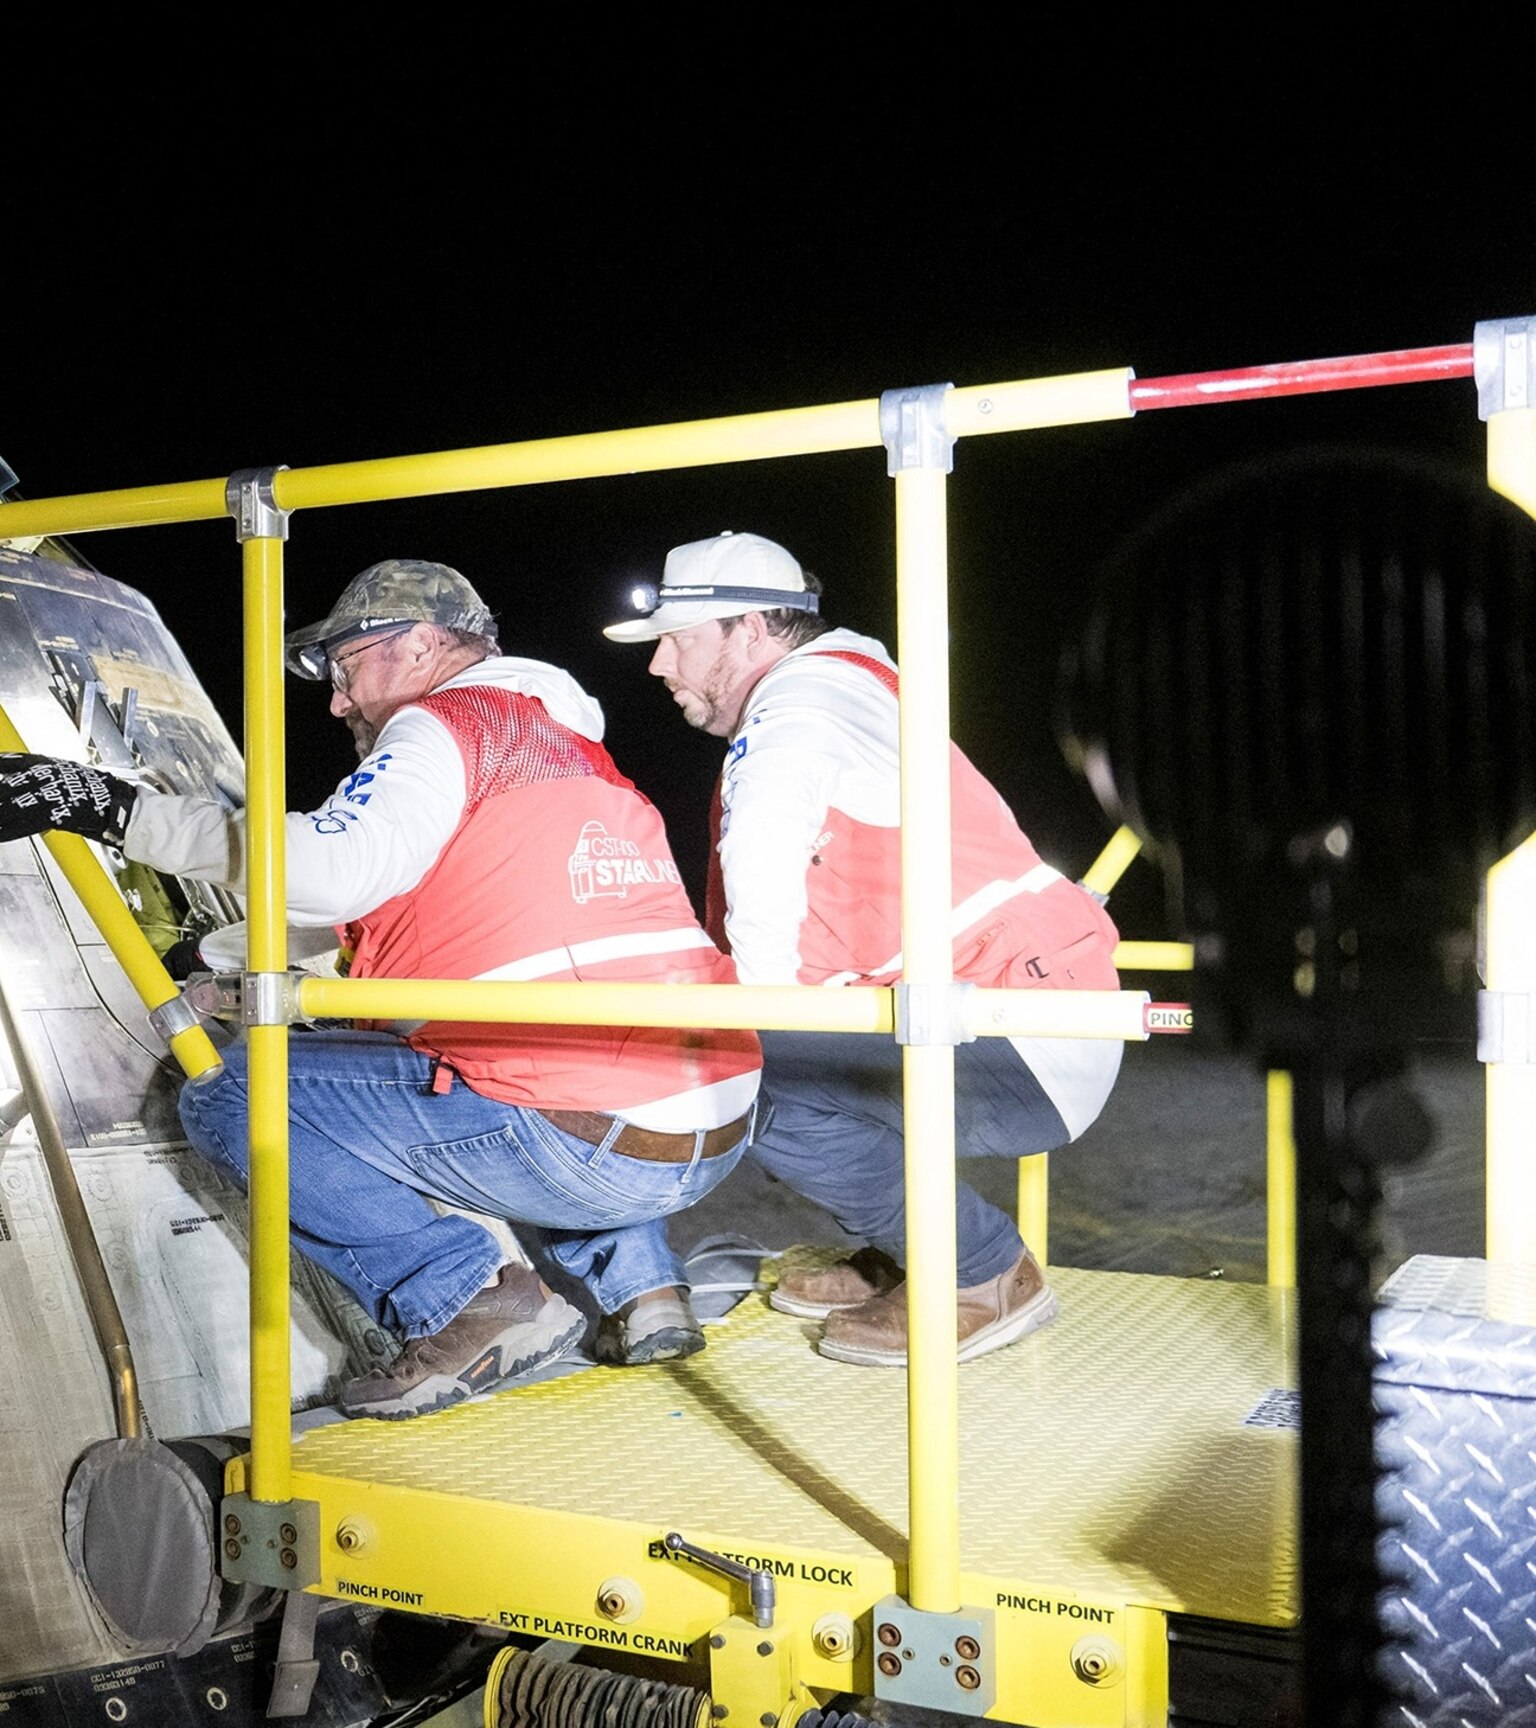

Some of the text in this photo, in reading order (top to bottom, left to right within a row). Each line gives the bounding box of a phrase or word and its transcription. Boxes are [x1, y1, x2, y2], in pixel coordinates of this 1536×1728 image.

[1150, 1012, 1193, 1027] PINC
[801, 1563, 854, 1587] LOCK
[337, 1581, 424, 1606] PINCH POINT
[996, 1593, 1115, 1624] PINCH POINT
[499, 1611, 694, 1659] EXT PLATFORM CRANK
